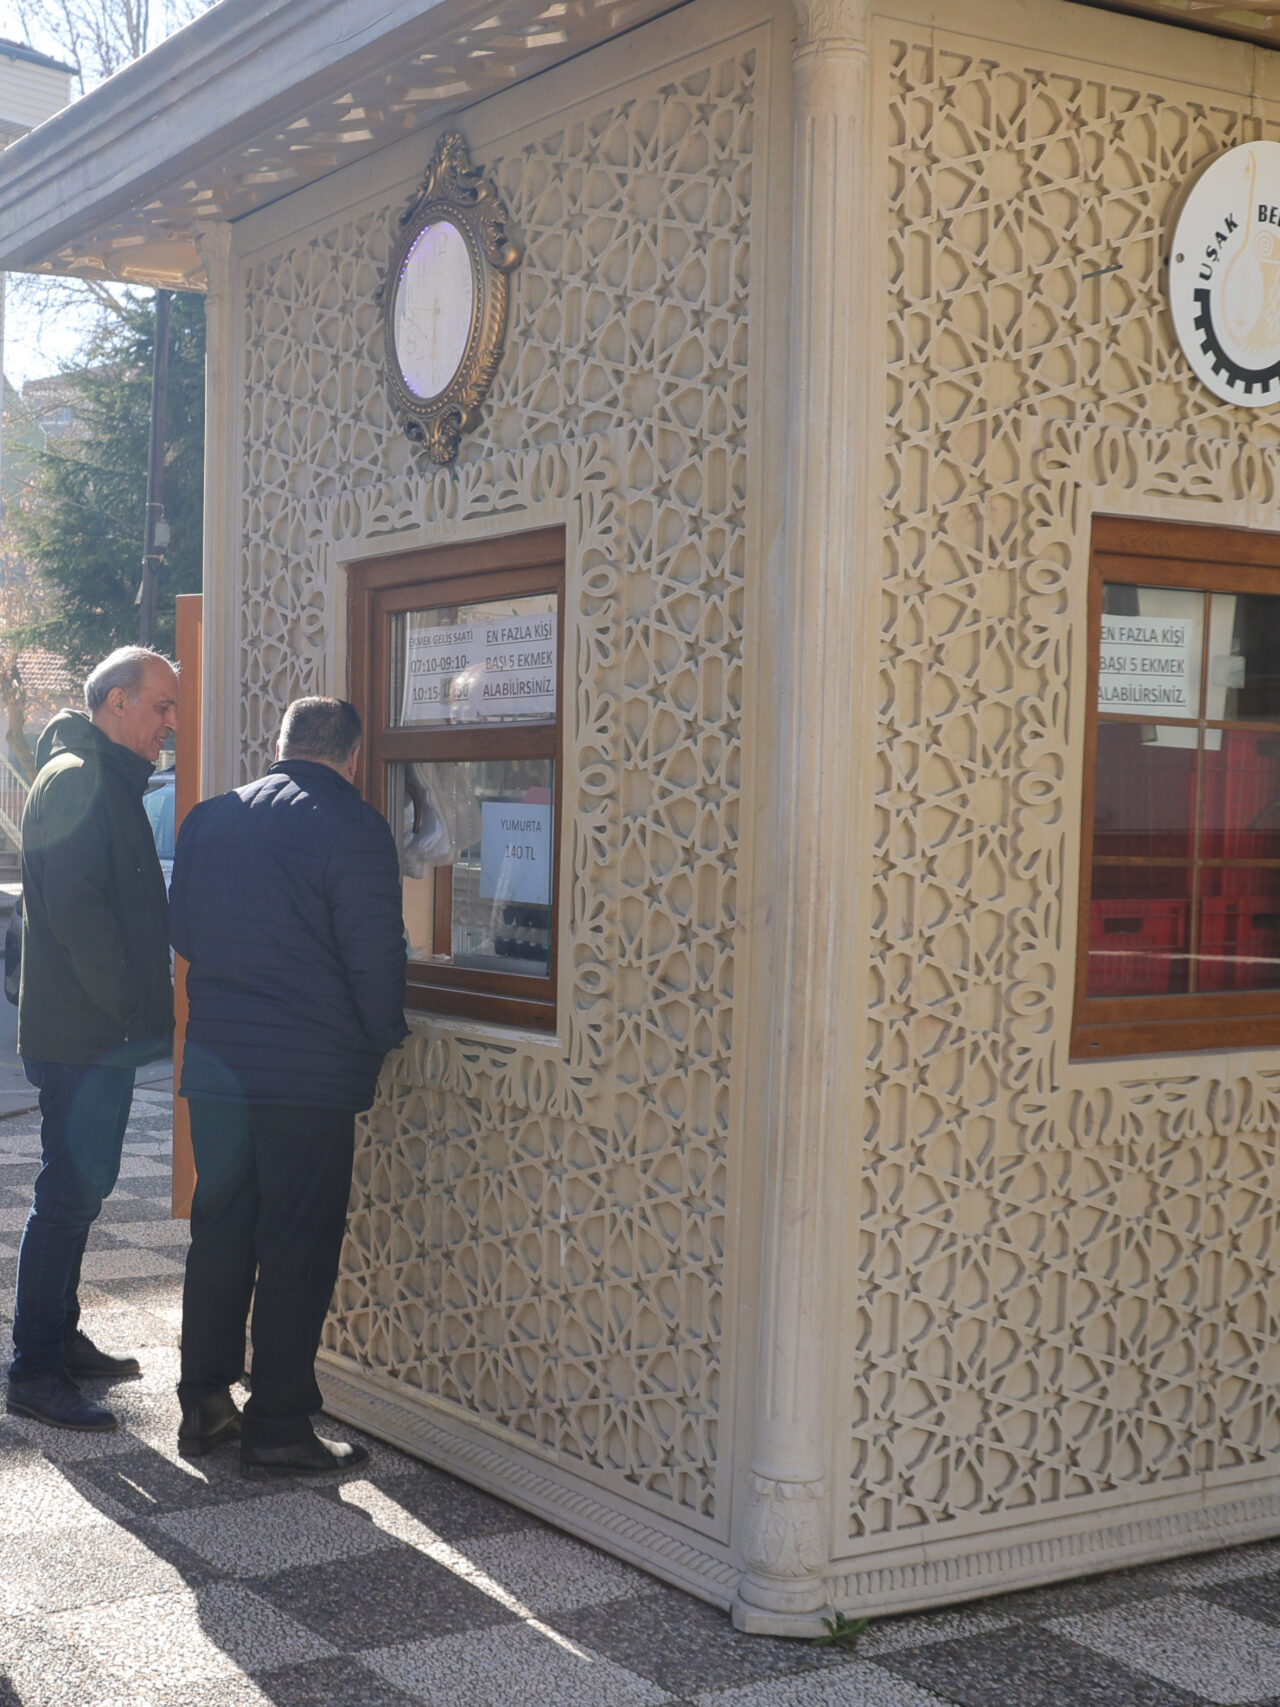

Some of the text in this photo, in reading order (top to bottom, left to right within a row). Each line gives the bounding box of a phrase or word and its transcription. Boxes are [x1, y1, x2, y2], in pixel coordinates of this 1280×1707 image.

[1198, 204, 1280, 281] UŞAK BE
[432, 632, 452, 645] GELİŞ
[453, 628, 473, 642] SAATİ
[486, 620, 552, 643] EN FAZLA KİŞİ
[1100, 626, 1184, 645] EN FAZLA KİŞİ
[410, 654, 470, 673] 07:10-09:10-
[486, 651, 552, 672] BAŞI 5 EKMEK
[1099, 656, 1184, 673] BAŞI 5 EKMEK
[482, 676, 554, 697] ALABİLİRSİNİZ.
[500, 819, 542, 832] YUMURTA
[505, 845, 536, 860] 140 TL
